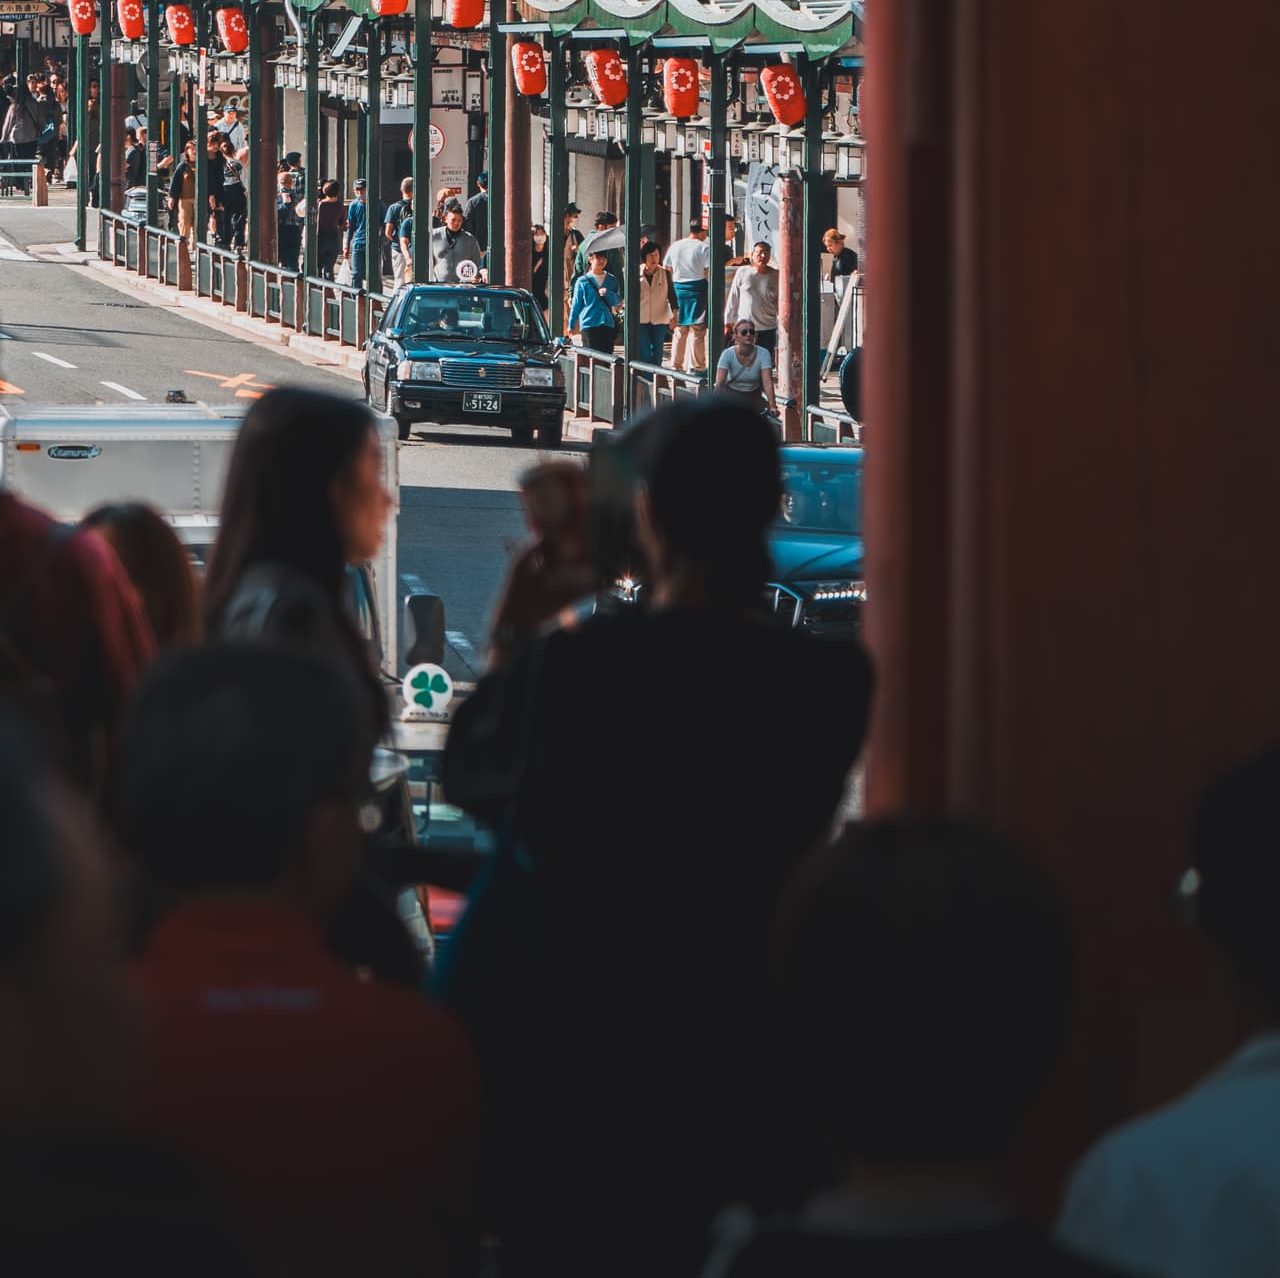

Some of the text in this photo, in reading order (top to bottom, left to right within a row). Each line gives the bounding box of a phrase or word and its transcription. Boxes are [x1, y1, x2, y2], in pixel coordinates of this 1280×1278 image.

[755, 165, 777, 240] メロンパ
[471, 399, 498, 411] 51-24
